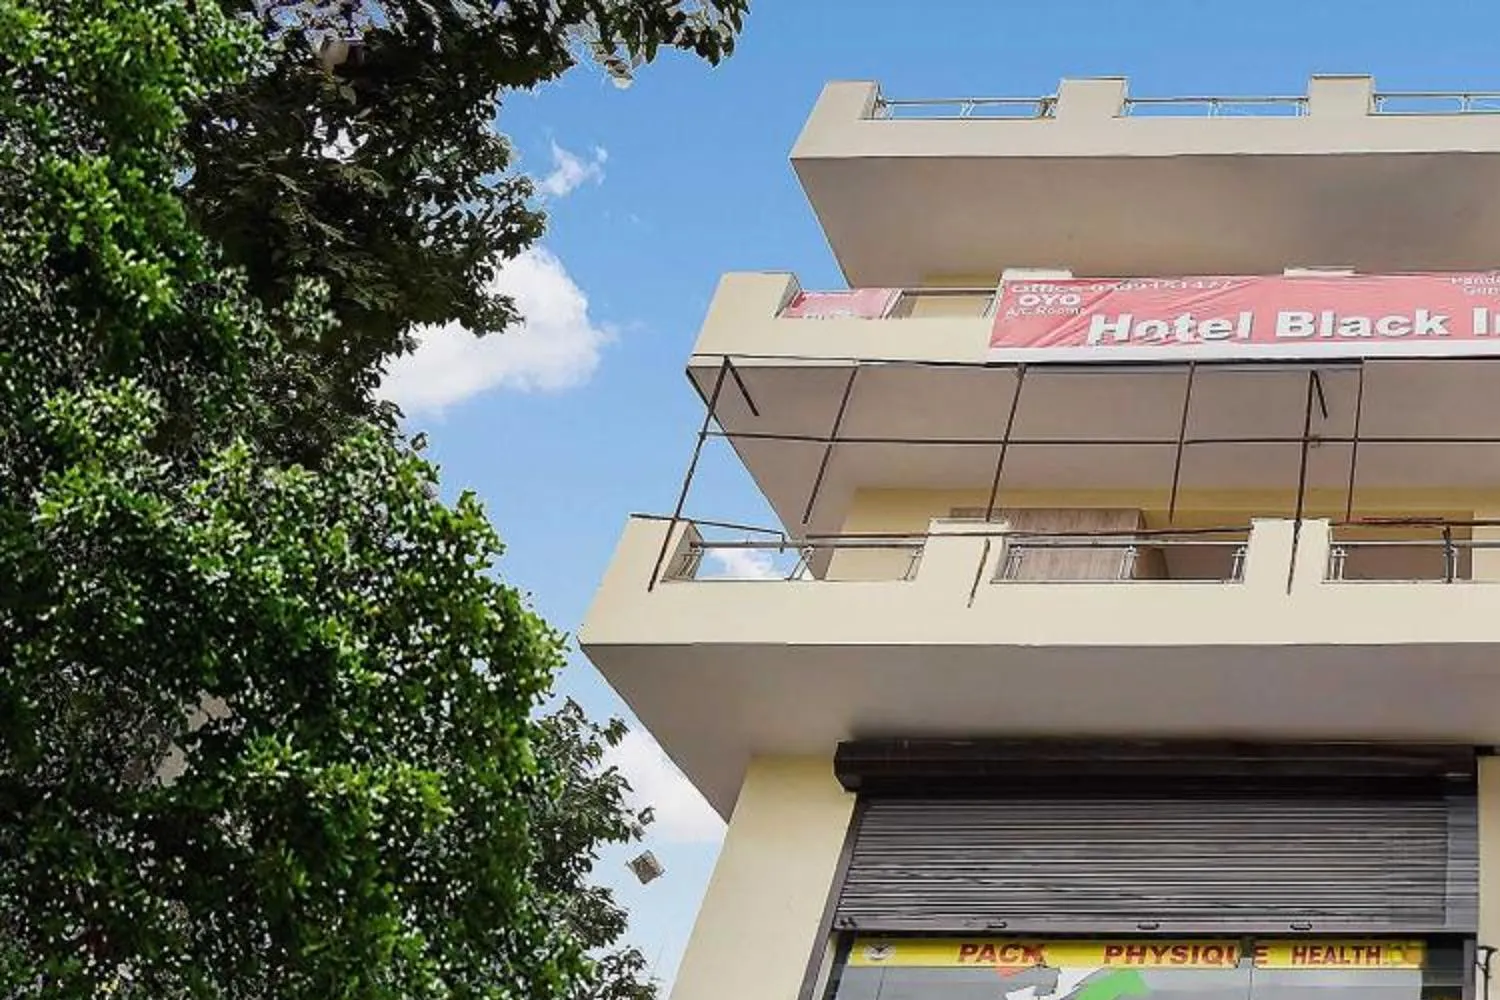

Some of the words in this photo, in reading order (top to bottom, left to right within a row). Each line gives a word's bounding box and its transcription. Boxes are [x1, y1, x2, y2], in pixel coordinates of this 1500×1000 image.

[1019, 294, 1082, 307] OYO
[1088, 311, 1254, 345] Hotel
[1275, 306, 1452, 340] Black
[957, 943, 1045, 964] PACK
[1291, 945, 1381, 966] HEALTH
